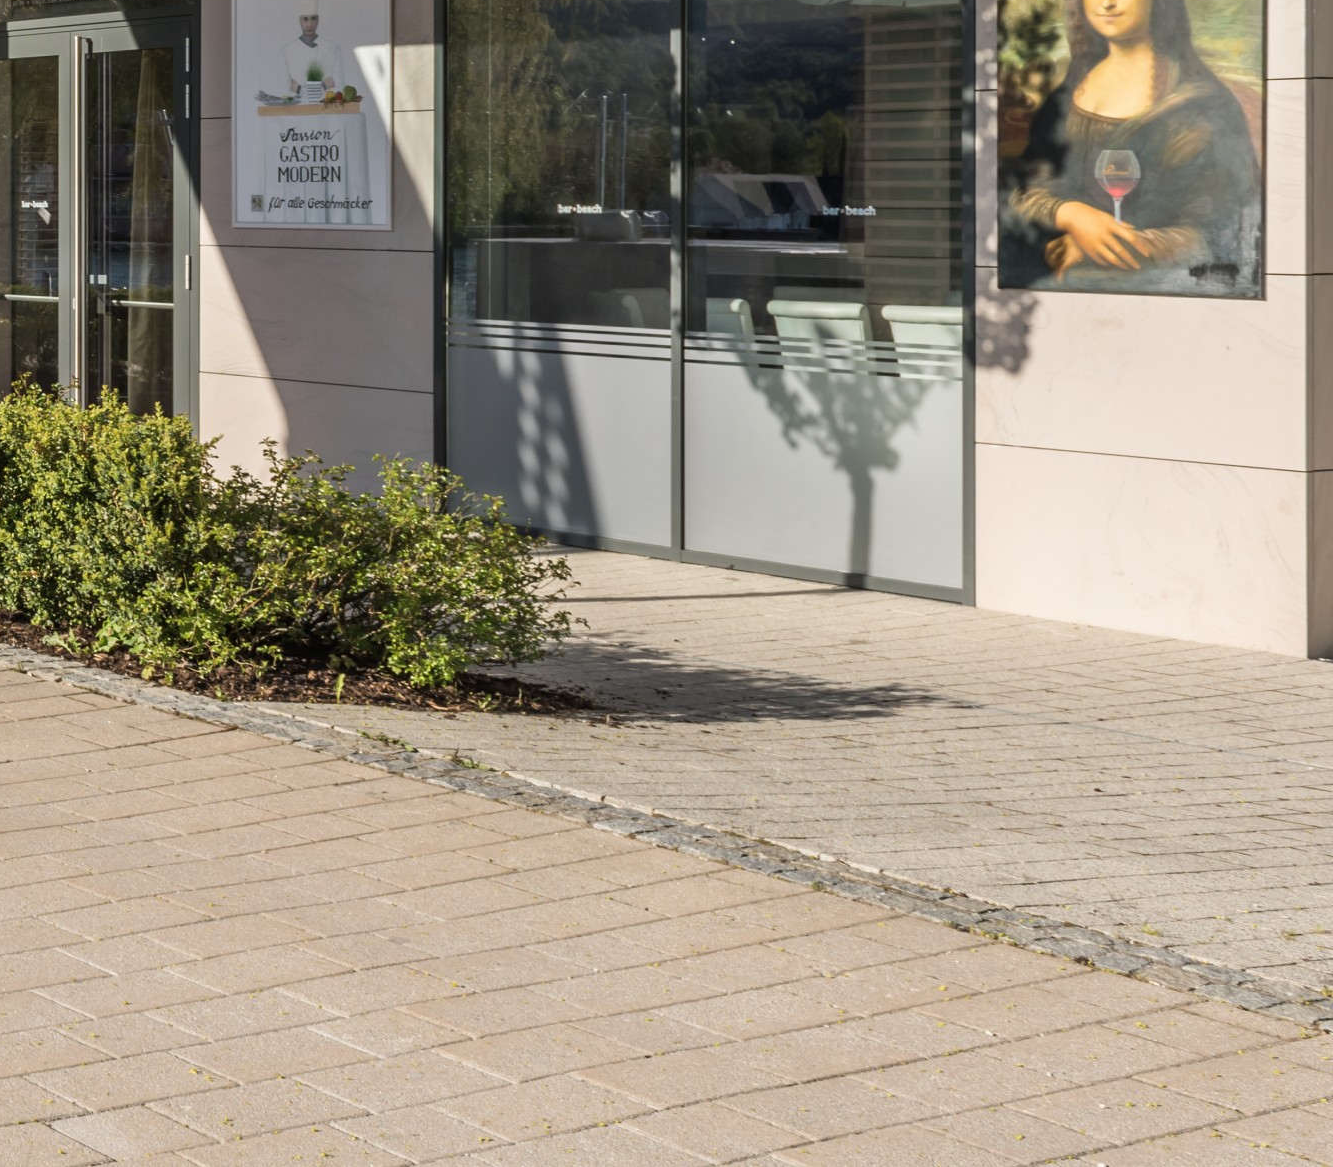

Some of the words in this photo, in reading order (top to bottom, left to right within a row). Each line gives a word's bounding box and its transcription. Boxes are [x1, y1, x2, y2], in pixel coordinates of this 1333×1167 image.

[279, 127, 340, 142] Passion
[279, 145, 339, 162] GASTRO
[278, 166, 341, 183] MODERN
[268, 197, 285, 213] für
[287, 196, 305, 209] alle
[307, 194, 373, 210] Geschmäcker
